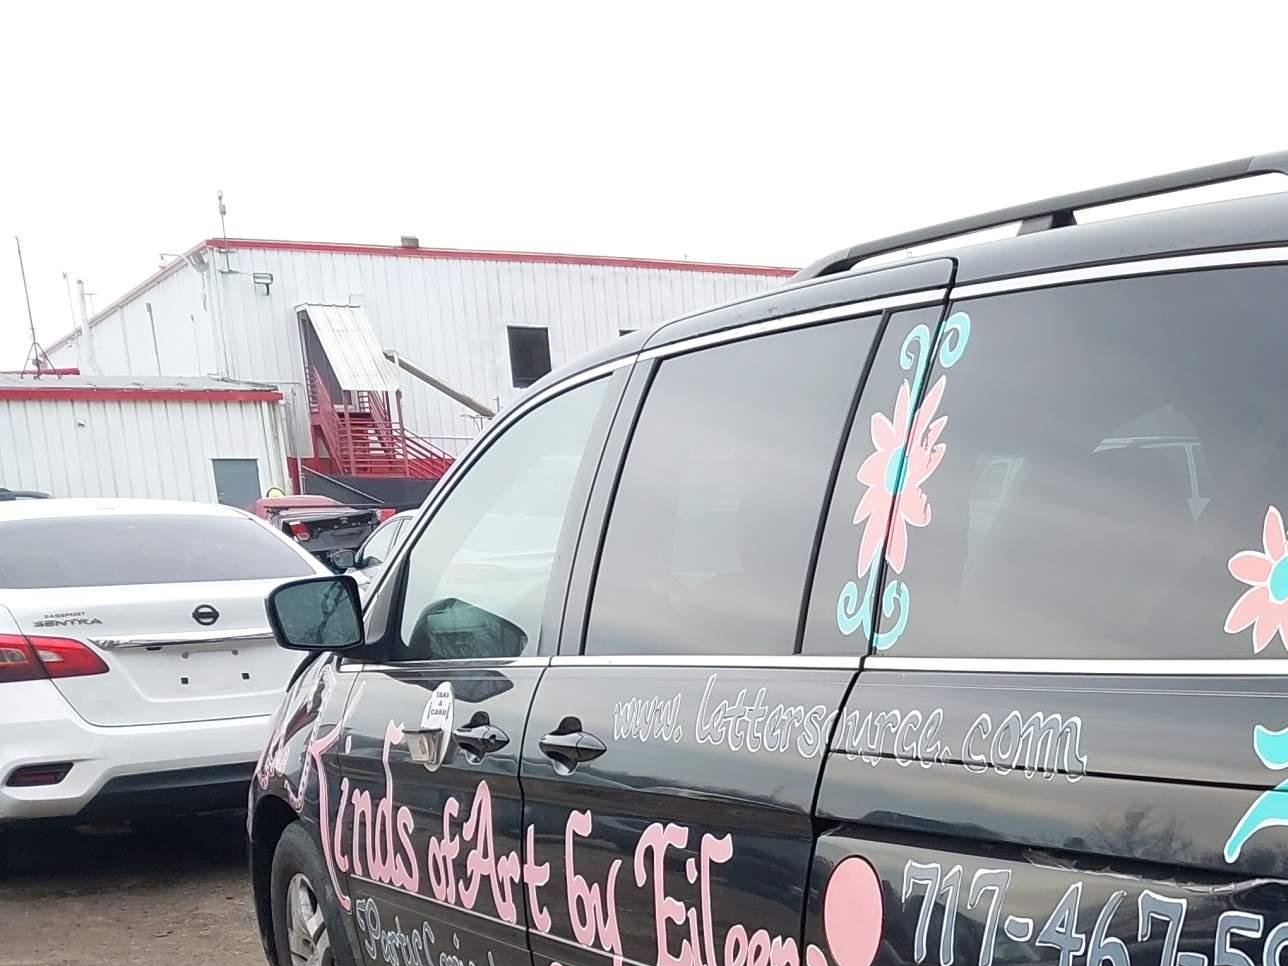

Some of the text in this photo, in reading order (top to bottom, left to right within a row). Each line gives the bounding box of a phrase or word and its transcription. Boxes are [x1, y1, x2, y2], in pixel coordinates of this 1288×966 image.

[33, 617, 104, 628] SENTRA
[427, 797, 460, 903] of
[458, 780, 550, 934] Art
